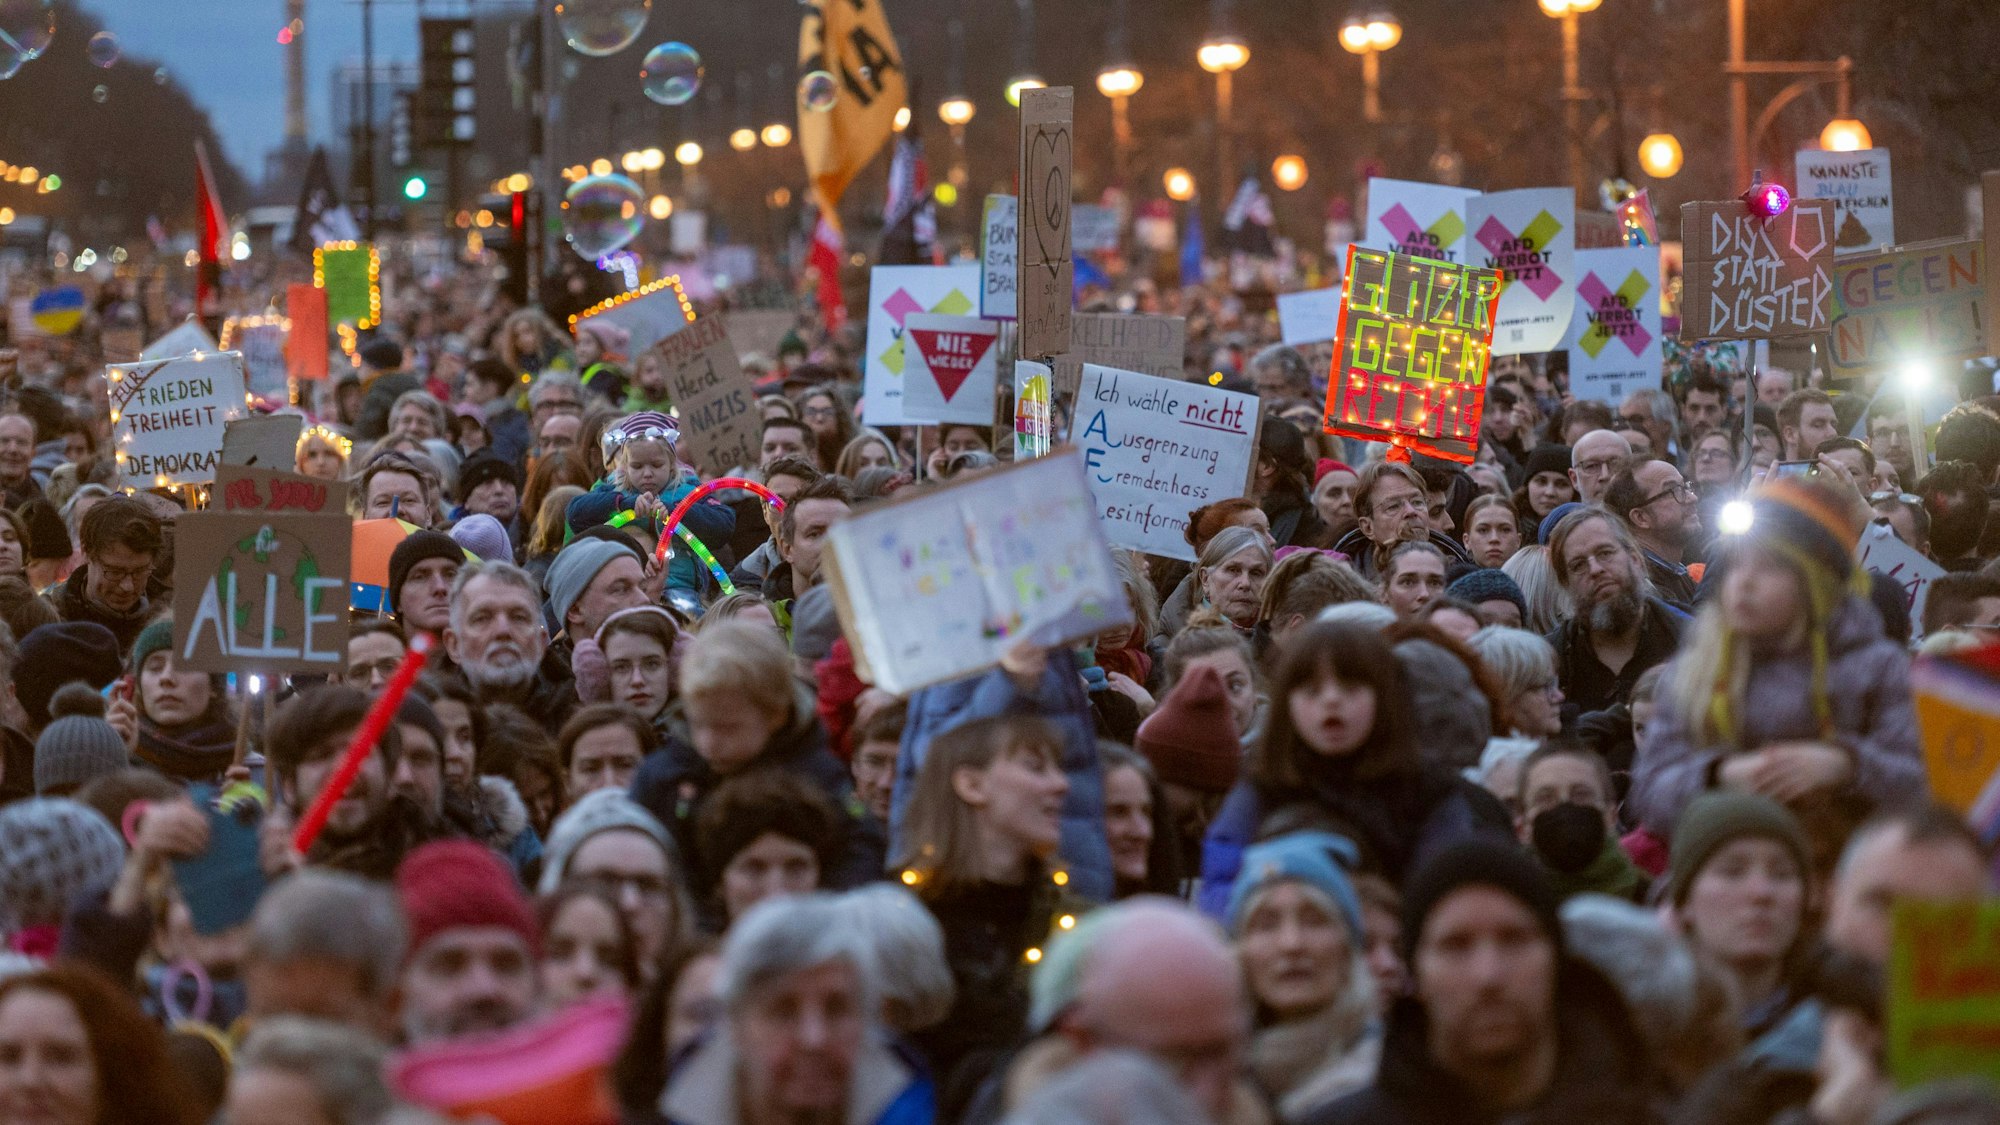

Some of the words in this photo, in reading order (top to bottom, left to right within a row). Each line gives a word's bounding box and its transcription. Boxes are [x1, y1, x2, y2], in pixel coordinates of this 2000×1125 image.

[1808, 162, 1878, 179] KANNSTE
[1814, 182, 1858, 197] BLAU
[1406, 231, 1440, 246] AFD
[1501, 238, 1534, 253] AFD
[1484, 251, 1552, 269] VERBOT
[1712, 253, 1786, 293] STATT
[1503, 267, 1543, 282] ETZT
[1843, 250, 1979, 309] GEGEN
[1602, 295, 1628, 307] AFD
[1708, 264, 1833, 336] DÜSTER
[1586, 308, 1643, 324] VERBOT
[656, 314, 727, 369] FRAUEN
[937, 333, 972, 355] NIE
[1596, 324, 1637, 337] JETZT
[928, 355, 975, 369] WIEDER
[1351, 318, 1488, 386] GEGEN
[136, 378, 214, 406] FRIEDEN
[1095, 372, 1119, 404] Ich
[1128, 389, 1179, 415] wähle
[1185, 397, 1244, 429] nicht
[125, 406, 217, 433] FREIHEIT
[688, 390, 747, 435] NAZIS
[1083, 409, 1219, 475] Ausgrenzung
[1085, 447, 1209, 499] Fremdenhass
[183, 571, 343, 662] ALLE
